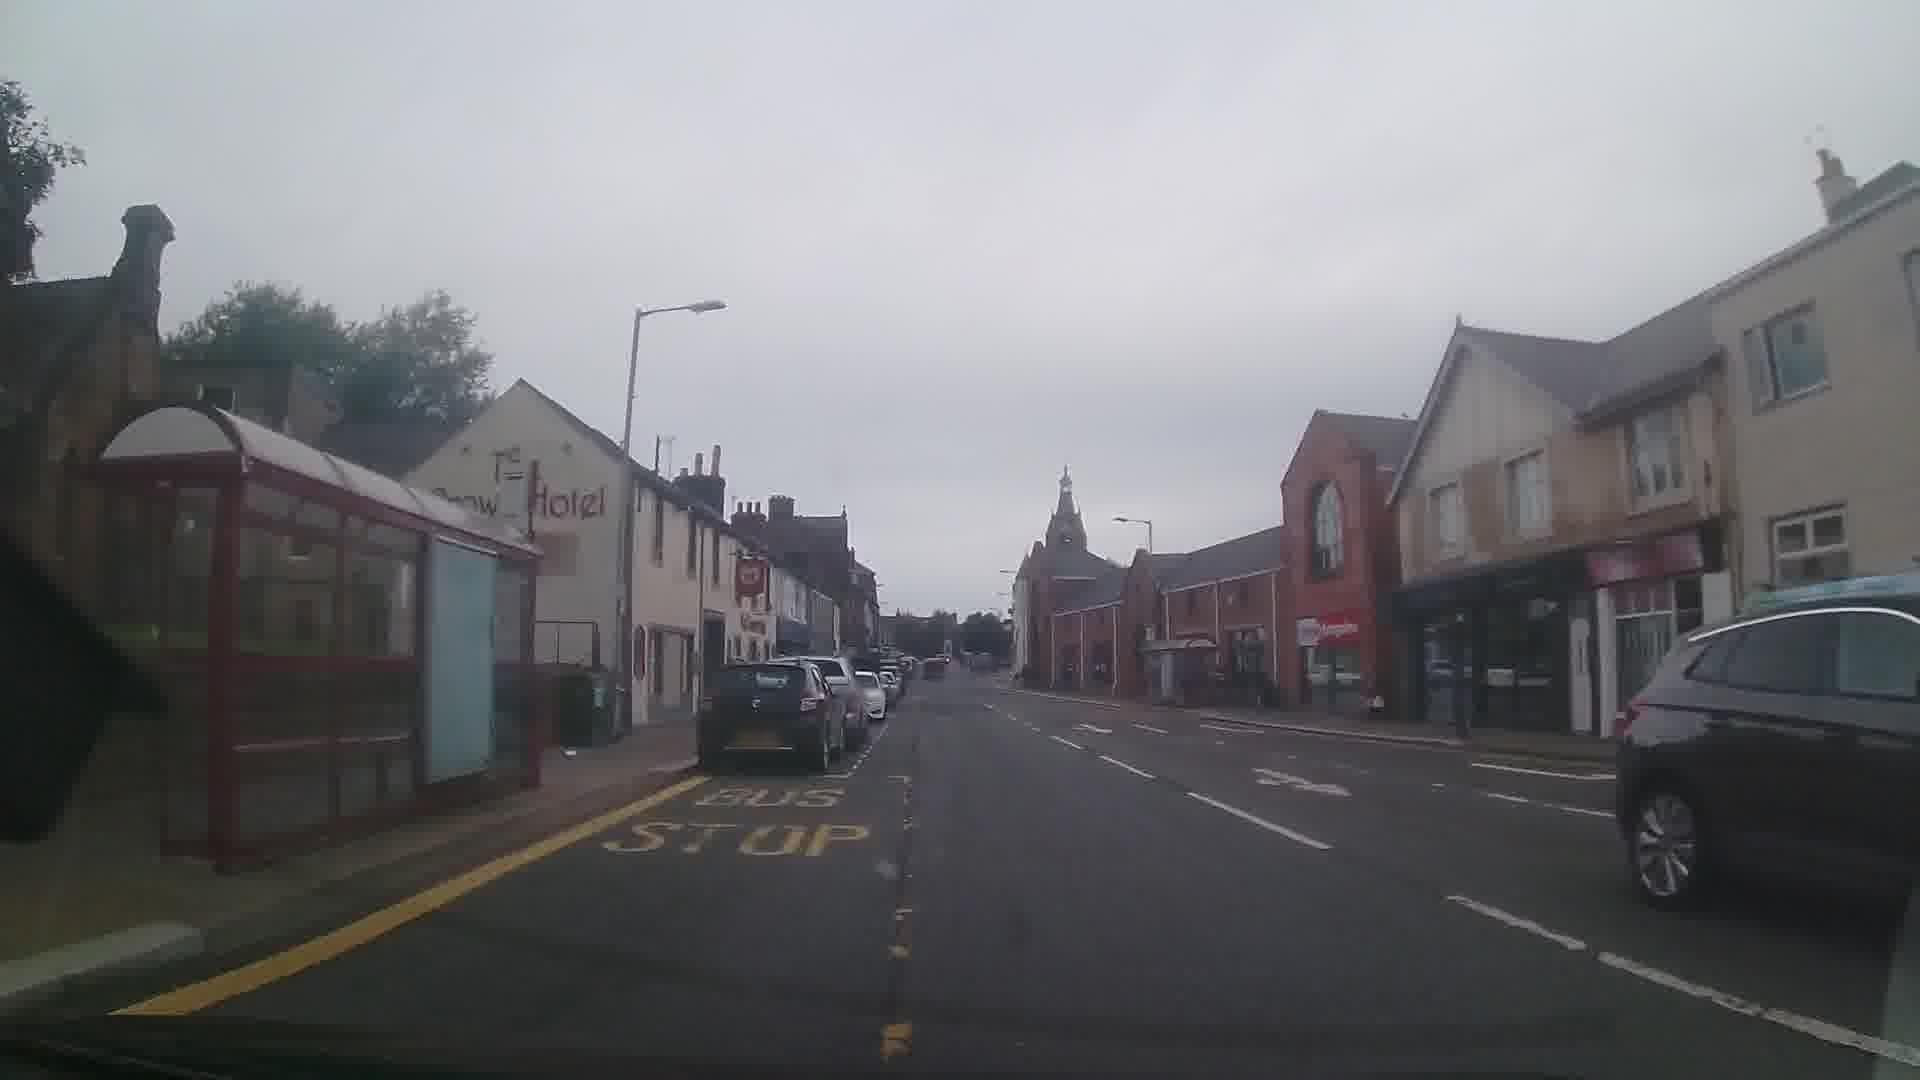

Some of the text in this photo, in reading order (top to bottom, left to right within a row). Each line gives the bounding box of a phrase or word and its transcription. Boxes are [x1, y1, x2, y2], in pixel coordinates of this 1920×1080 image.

[533, 484, 606, 520] Hotel
[695, 788, 845, 807] BUS
[602, 822, 871, 857] STOP
